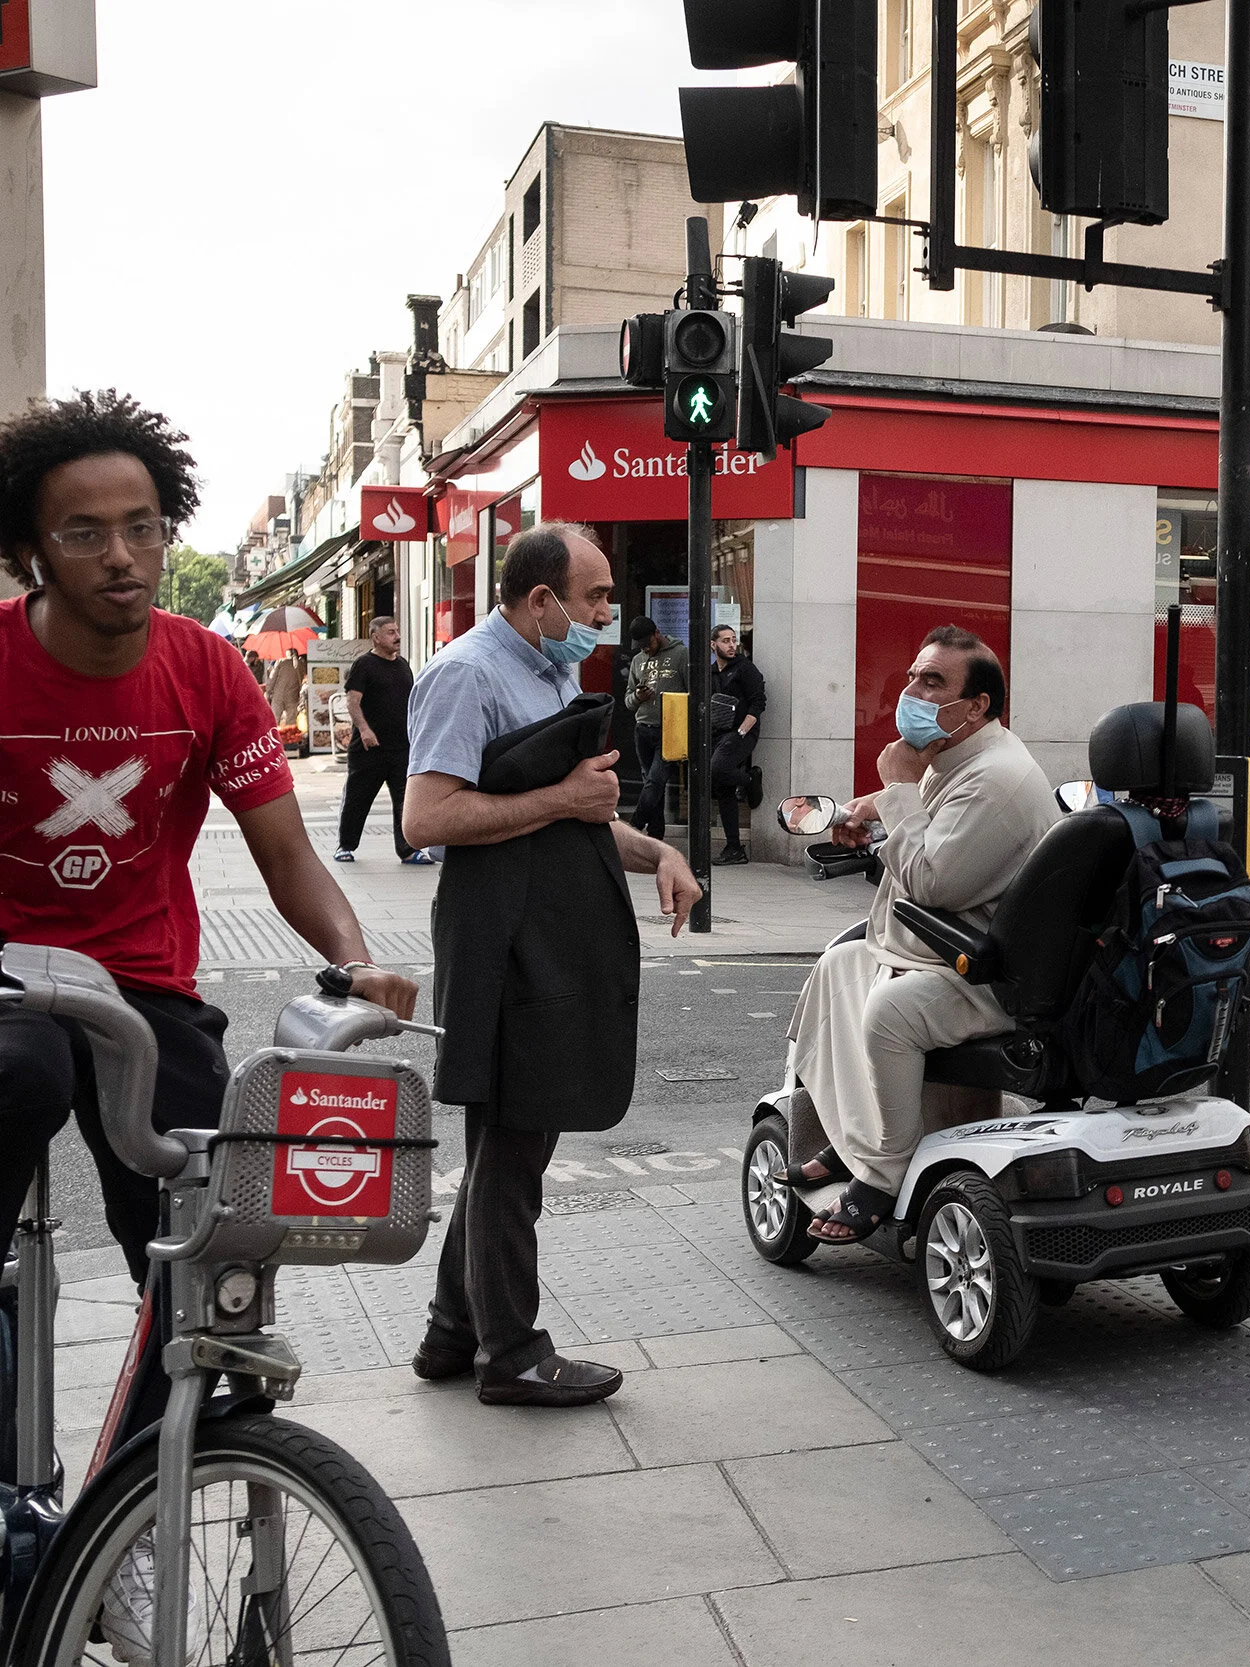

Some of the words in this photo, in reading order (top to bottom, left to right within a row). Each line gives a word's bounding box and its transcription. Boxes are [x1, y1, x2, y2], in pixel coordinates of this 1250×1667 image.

[1169, 64, 1186, 78] CH
[1191, 66, 1224, 83] STRE
[1176, 88, 1212, 100] ANTIQUES
[1213, 92, 1224, 101] SH
[1169, 103, 1197, 113] MINSTER
[613, 442, 759, 478] Santader
[64, 726, 139, 743] LONDON
[220, 768, 263, 793] PARIS
[1215, 775, 1232, 783] IANS
[62, 855, 101, 879] GP
[309, 1088, 388, 1111] Santander
[949, 1121, 1029, 1139] ROYALE
[317, 1155, 353, 1167] CYCLES
[1133, 1178, 1204, 1200] ROYALE
